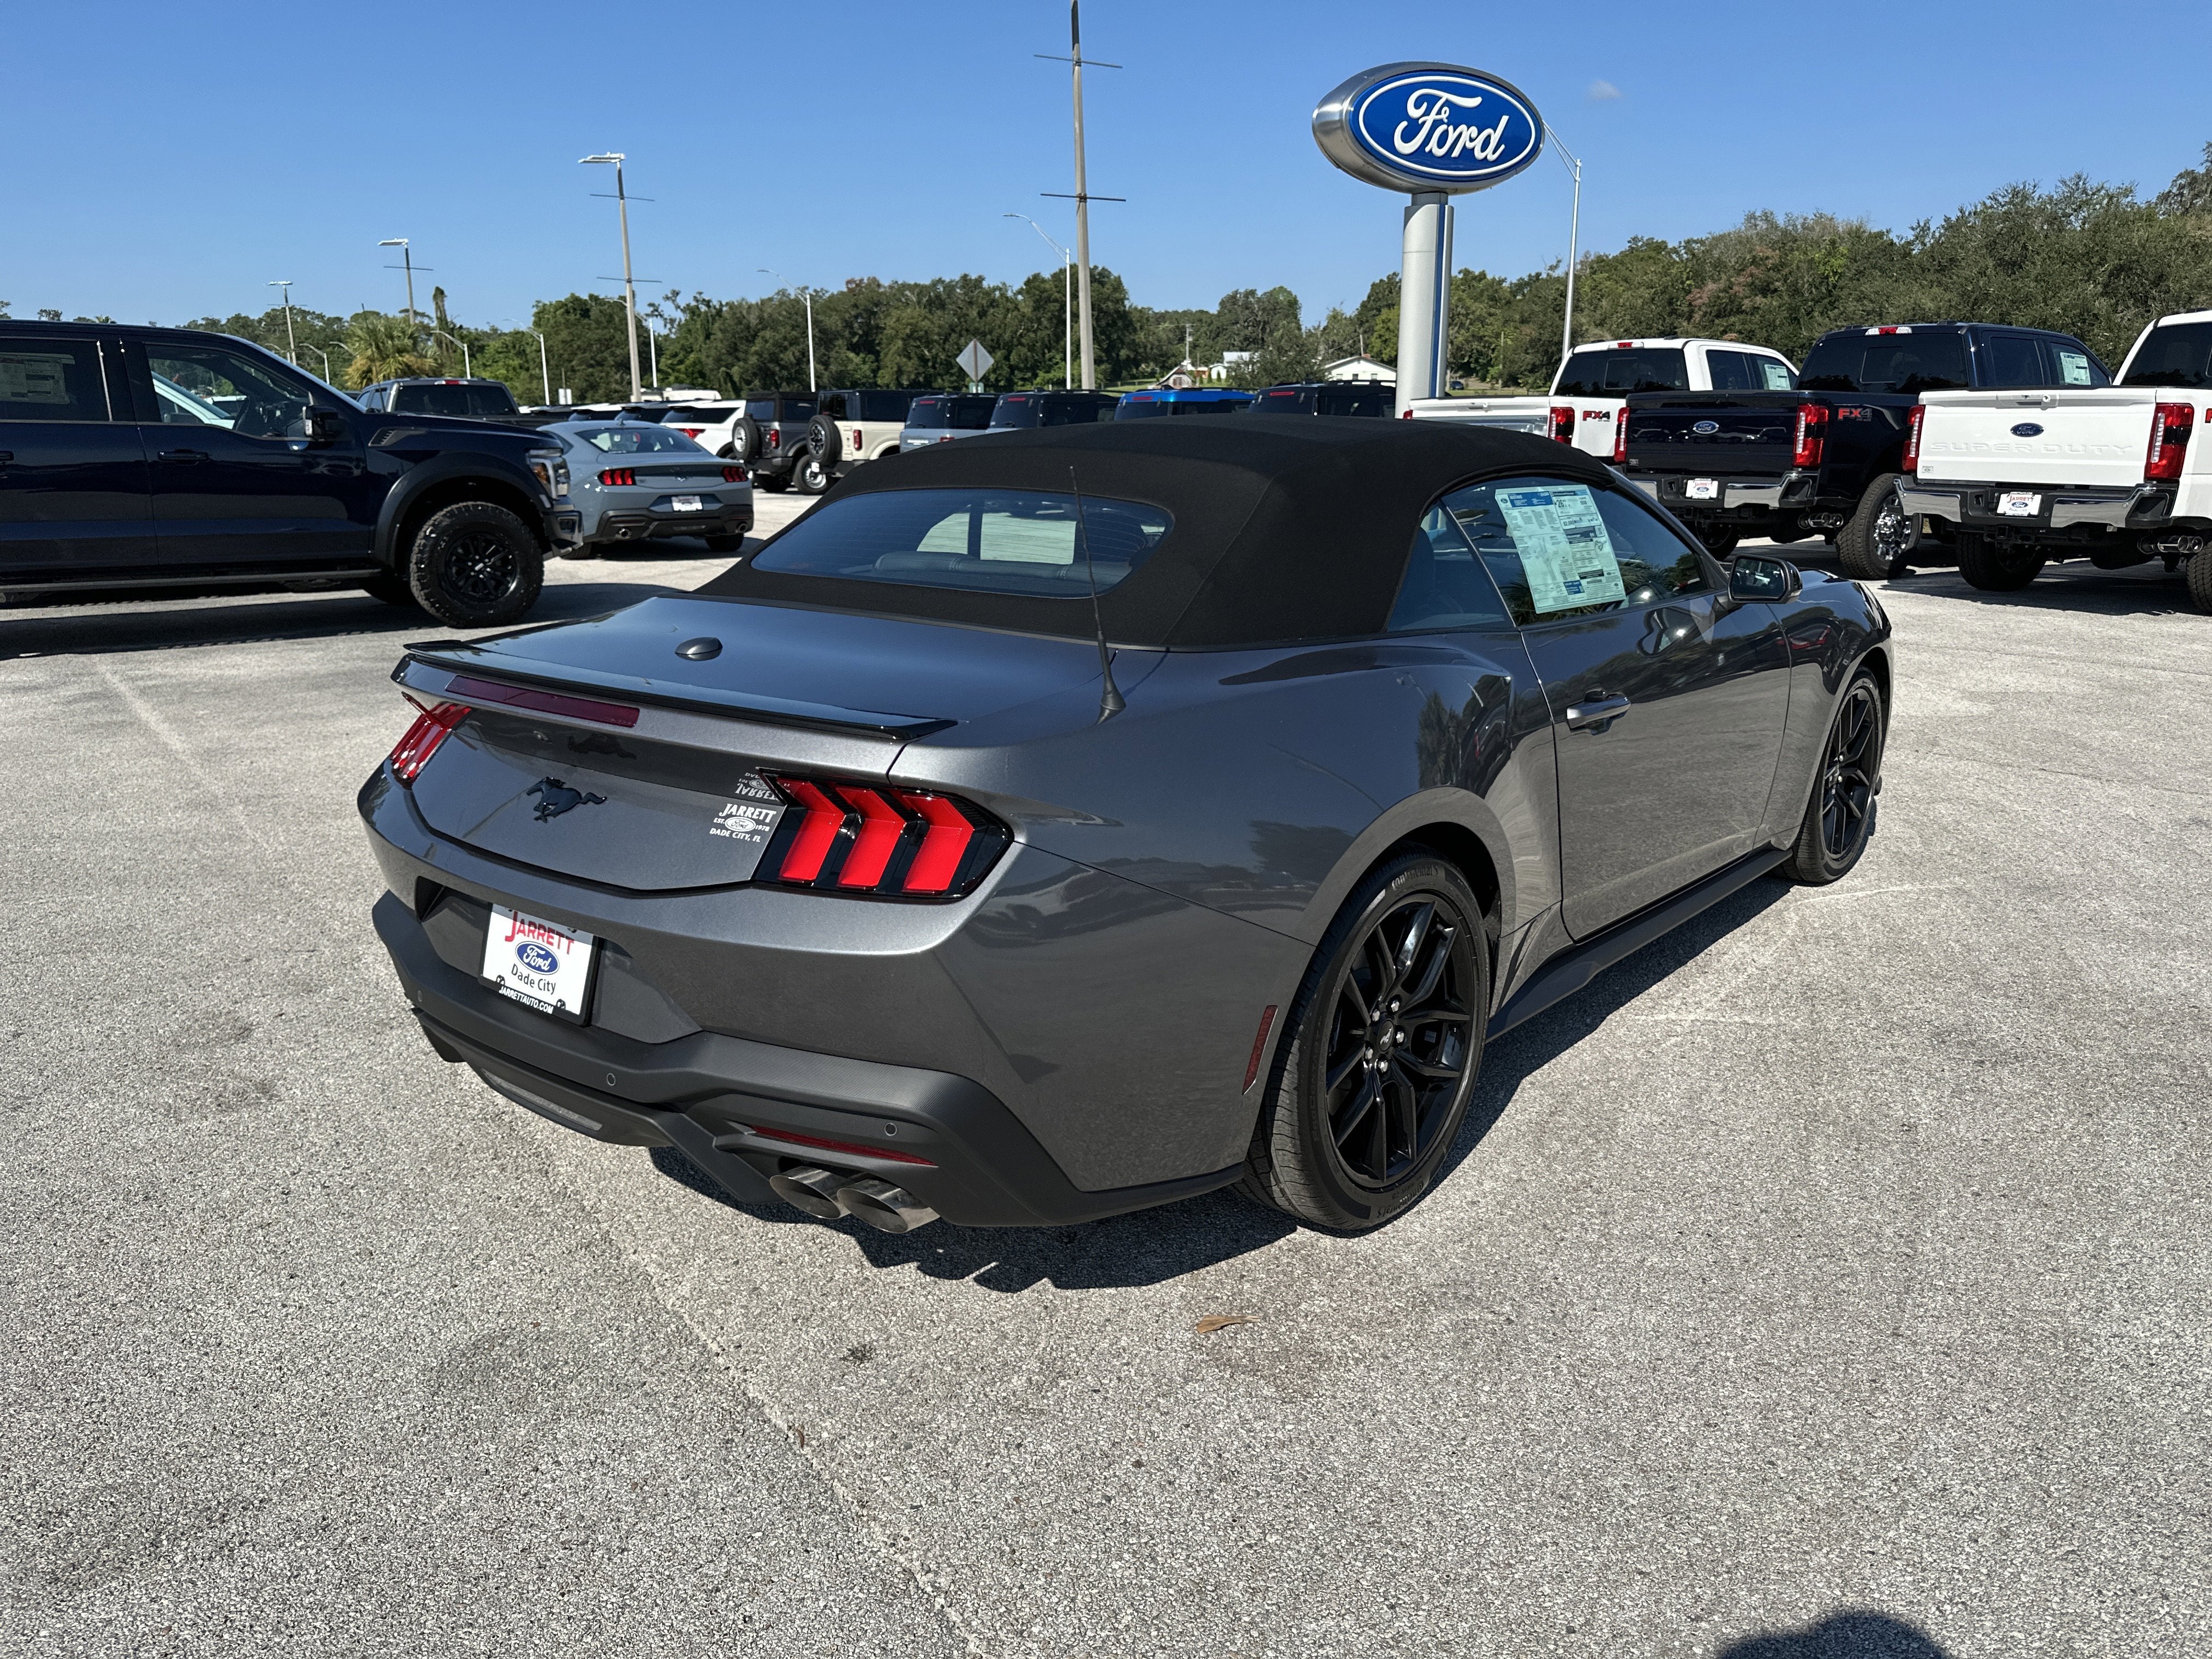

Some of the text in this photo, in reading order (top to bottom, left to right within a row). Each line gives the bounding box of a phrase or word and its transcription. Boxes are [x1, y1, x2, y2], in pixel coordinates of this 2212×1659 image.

[1393, 88, 1509, 162] Ford
[1583, 410, 1610, 421] FX4
[1838, 408, 1872, 421] FX4
[2016, 426, 2036, 435] Ford
[1930, 442, 2132, 455] SUPER DUTY
[2007, 495, 2034, 503] JARRETT
[719, 803, 777, 823] JARRETT
[731, 820, 749, 829] Ford
[709, 827, 732, 837] DADE
[505, 911, 574, 955] JARRETT
[523, 945, 552, 971] Ford
[511, 963, 556, 995] Dade City
[499, 986, 554, 1014] JARRETTAUTO.COM
